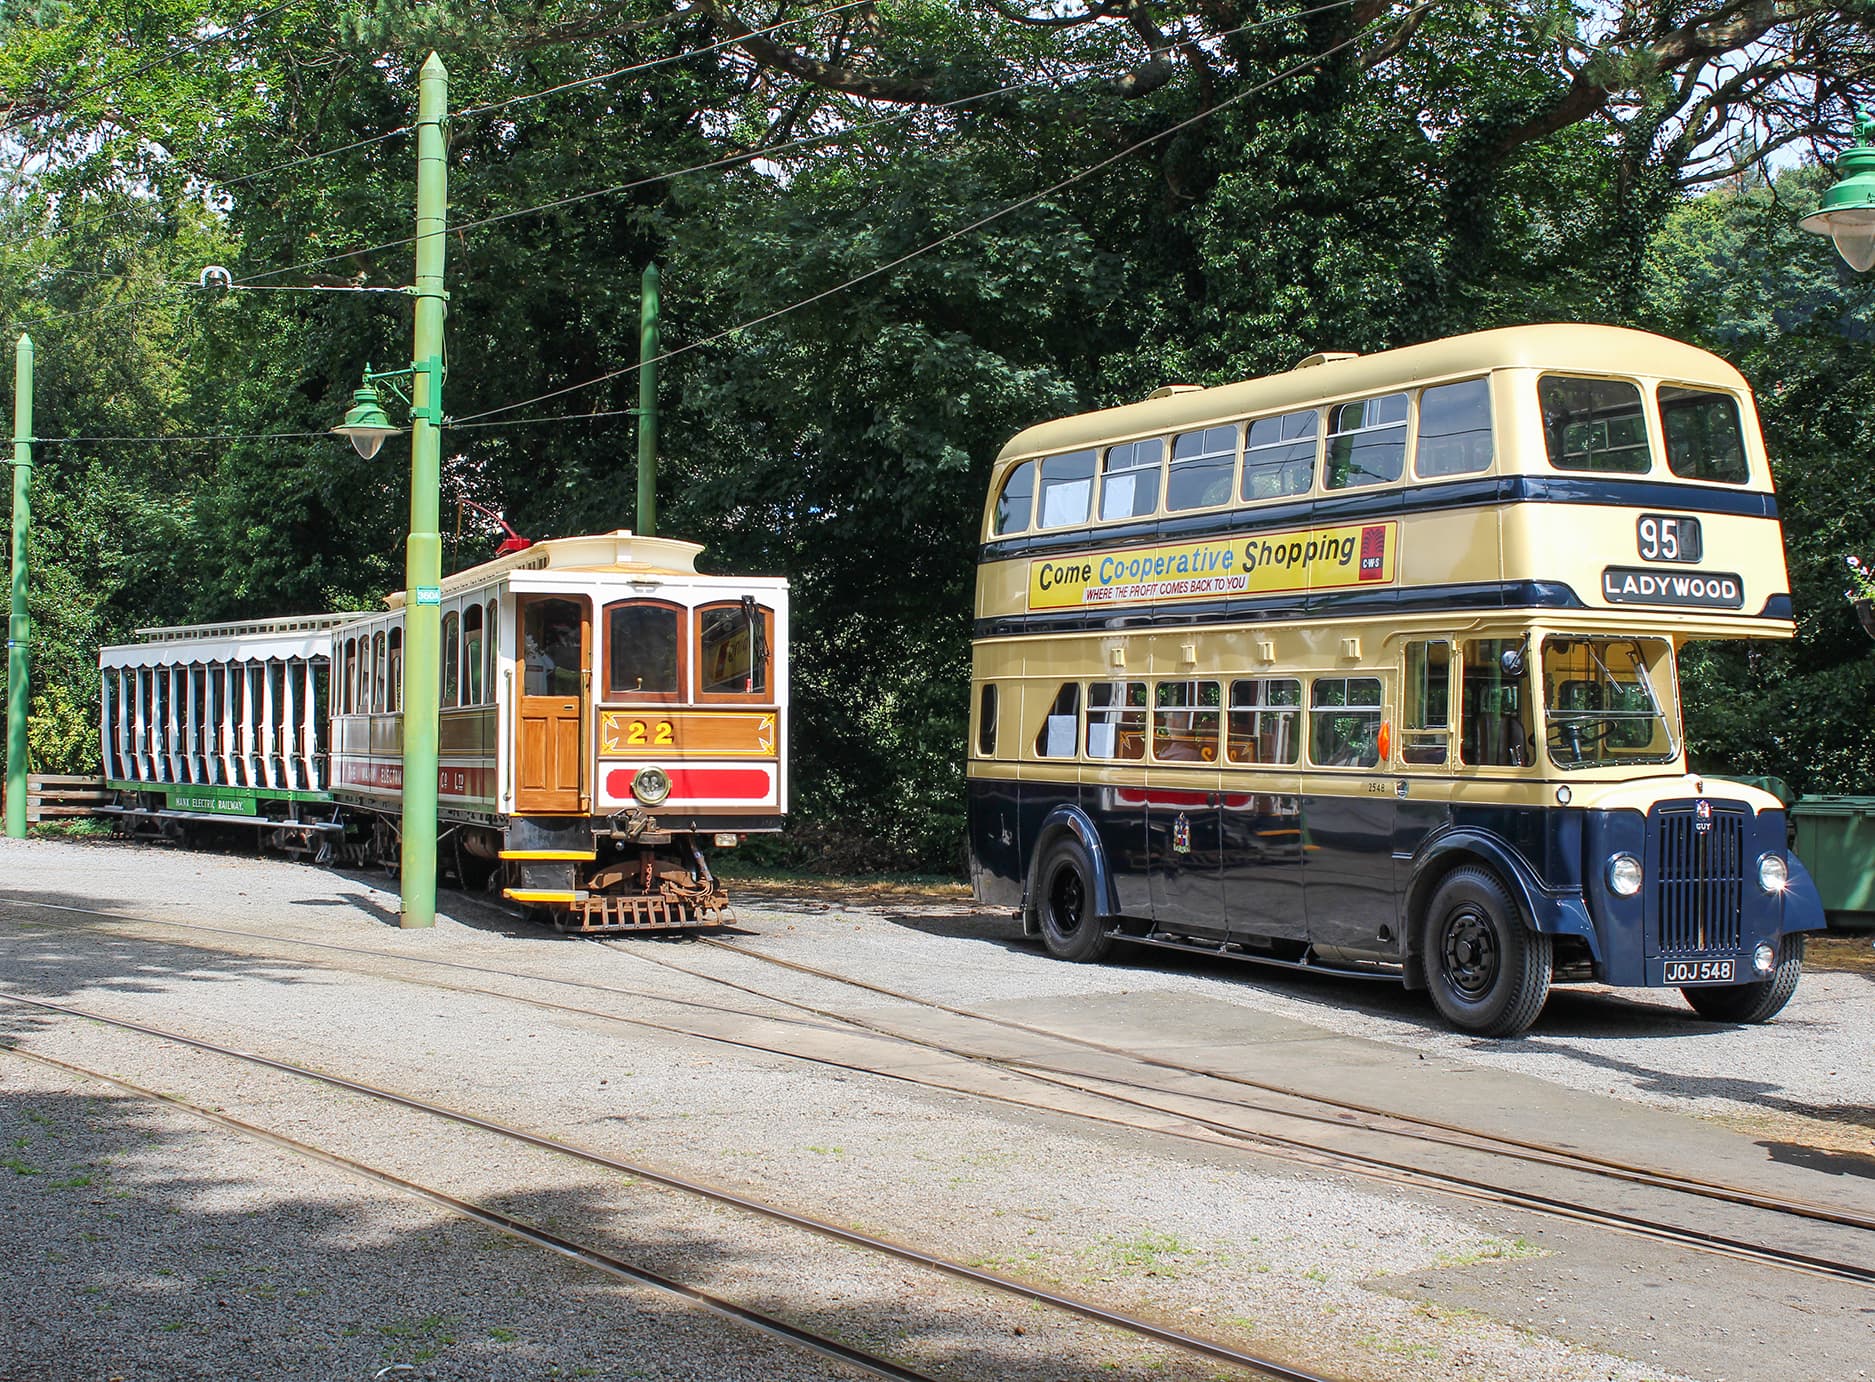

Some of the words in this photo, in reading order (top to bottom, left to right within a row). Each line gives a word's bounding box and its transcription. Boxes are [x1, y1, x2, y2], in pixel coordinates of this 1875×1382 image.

[1640, 519, 1678, 559] 95
[1039, 562, 1091, 591] Come
[1242, 534, 1356, 573] Shopping
[1086, 586, 1113, 600] WHERE
[1115, 585, 1128, 598] THE
[1129, 583, 1157, 597] PROFIT
[1159, 580, 1189, 594] COMES
[1190, 578, 1212, 592] BACK
[1214, 577, 1226, 590] TO
[1227, 576, 1246, 589] YOU
[1605, 574, 1736, 599] LADYWOOD
[192, 798, 215, 809] ELECTRIC
[1667, 963, 1697, 980] JOJ
[1700, 962, 1730, 979] 548
